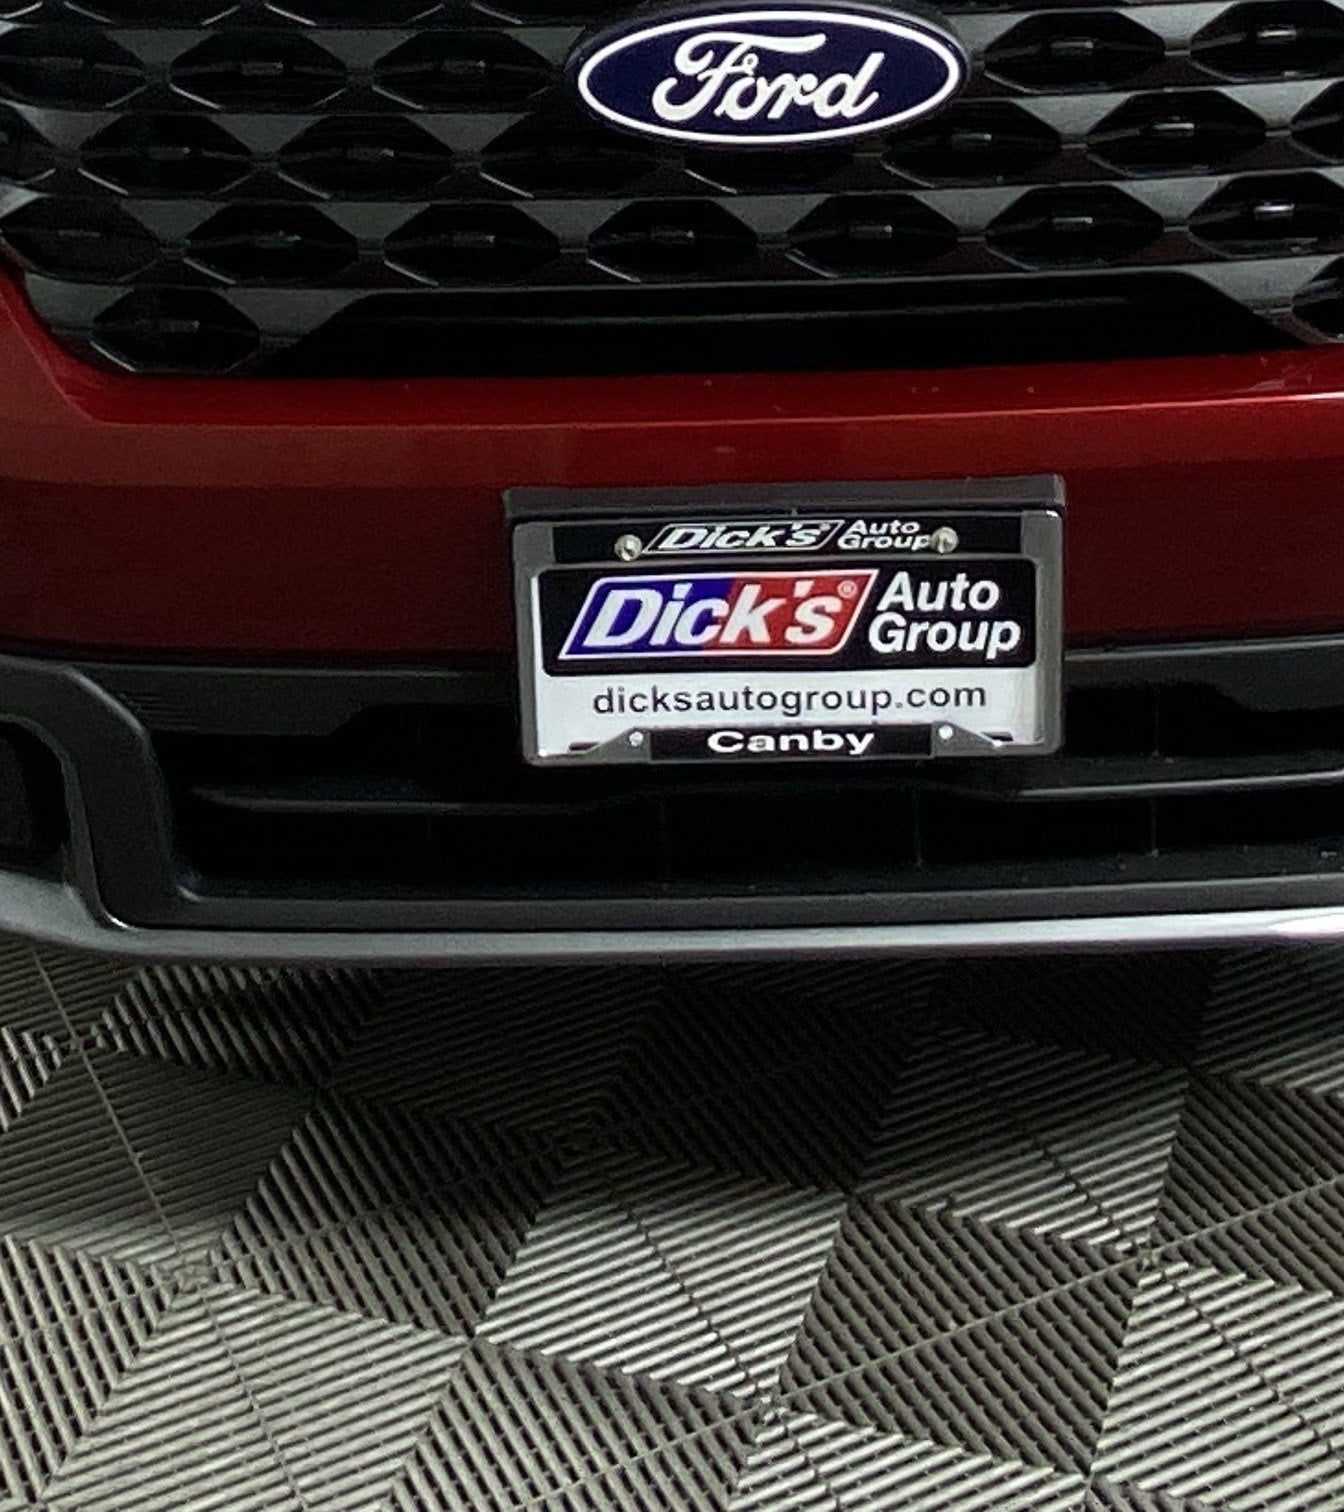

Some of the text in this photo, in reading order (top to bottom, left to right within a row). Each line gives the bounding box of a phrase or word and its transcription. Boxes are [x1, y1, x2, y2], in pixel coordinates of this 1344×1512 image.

[652, 31, 885, 121] Ford
[658, 521, 824, 551] Dick's
[837, 531, 932, 553] Group
[850, 519, 920, 536] Auto
[876, 572, 1000, 614] Auto
[582, 578, 842, 648] Dick's
[868, 612, 1022, 660] Group
[592, 684, 987, 718] dicksautogroup.com
[707, 730, 875, 756] Canby
